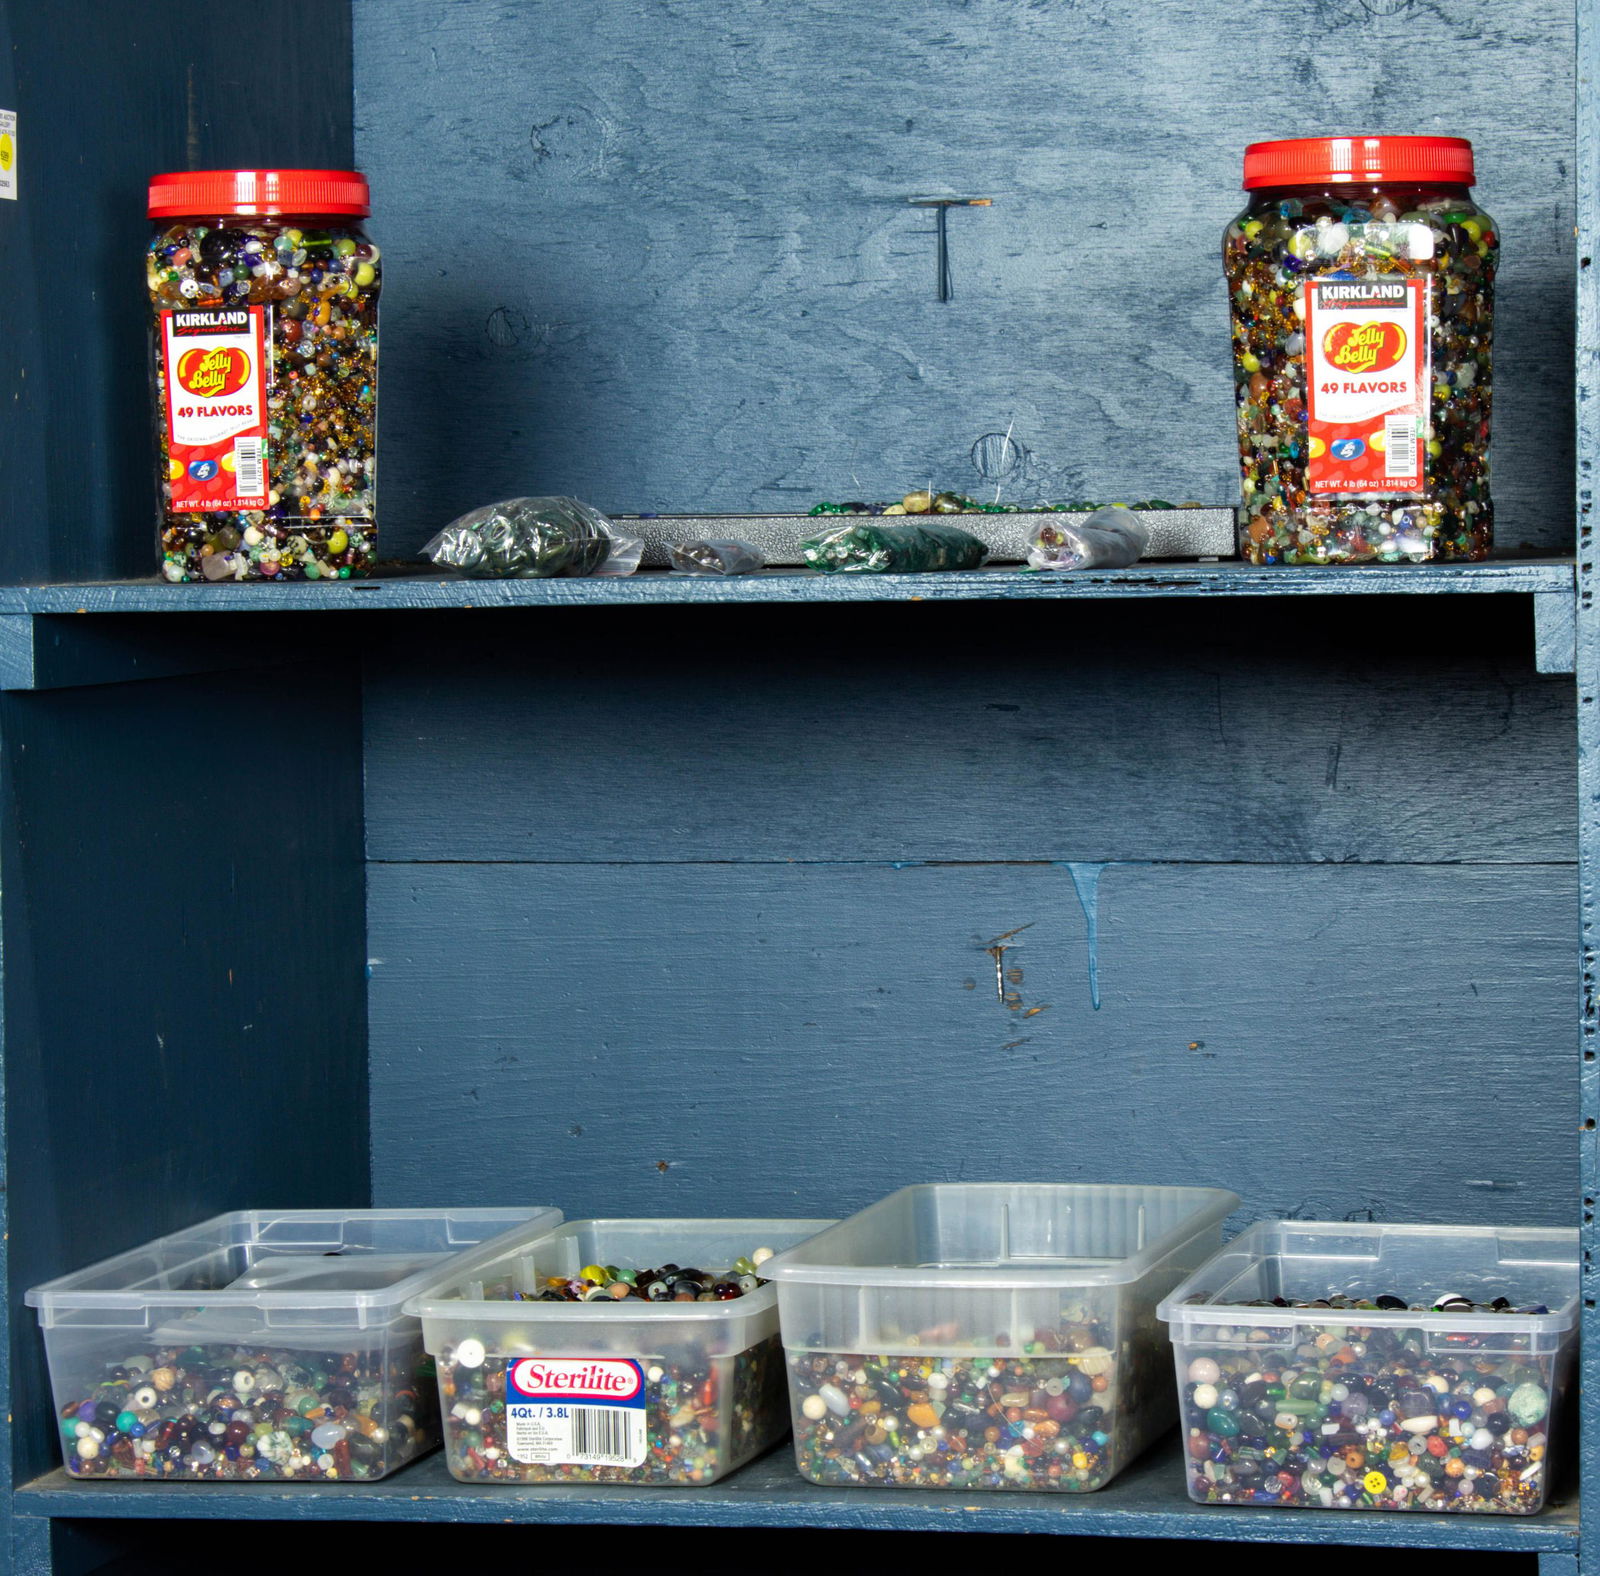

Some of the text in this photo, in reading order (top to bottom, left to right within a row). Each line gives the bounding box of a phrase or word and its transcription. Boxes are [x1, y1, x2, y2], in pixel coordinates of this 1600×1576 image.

[1322, 285, 1405, 299] KIRKLAND
[176, 312, 248, 327] KIRKLAND
[1347, 320, 1385, 349] Jelly
[199, 346, 232, 374] Jelly
[1334, 345, 1377, 374] Belly
[188, 370, 226, 398] Belly
[1321, 381, 1407, 394] 49 FLAVORS
[178, 404, 253, 418] 49 FLAVORS
[1315, 480, 1328, 488] NET
[1349, 479, 1355, 488] lb
[1356, 479, 1367, 488] (64
[1369, 480, 1379, 488] oz)
[1381, 479, 1399, 487] 1.814
[1400, 479, 1408, 488] kg
[176, 500, 188, 508] NET
[206, 499, 211, 507] lb
[222, 499, 232, 508] oz)
[233, 499, 249, 507] 1.814
[511, 1407, 569, 1418] 4Qt. / 3.8L
